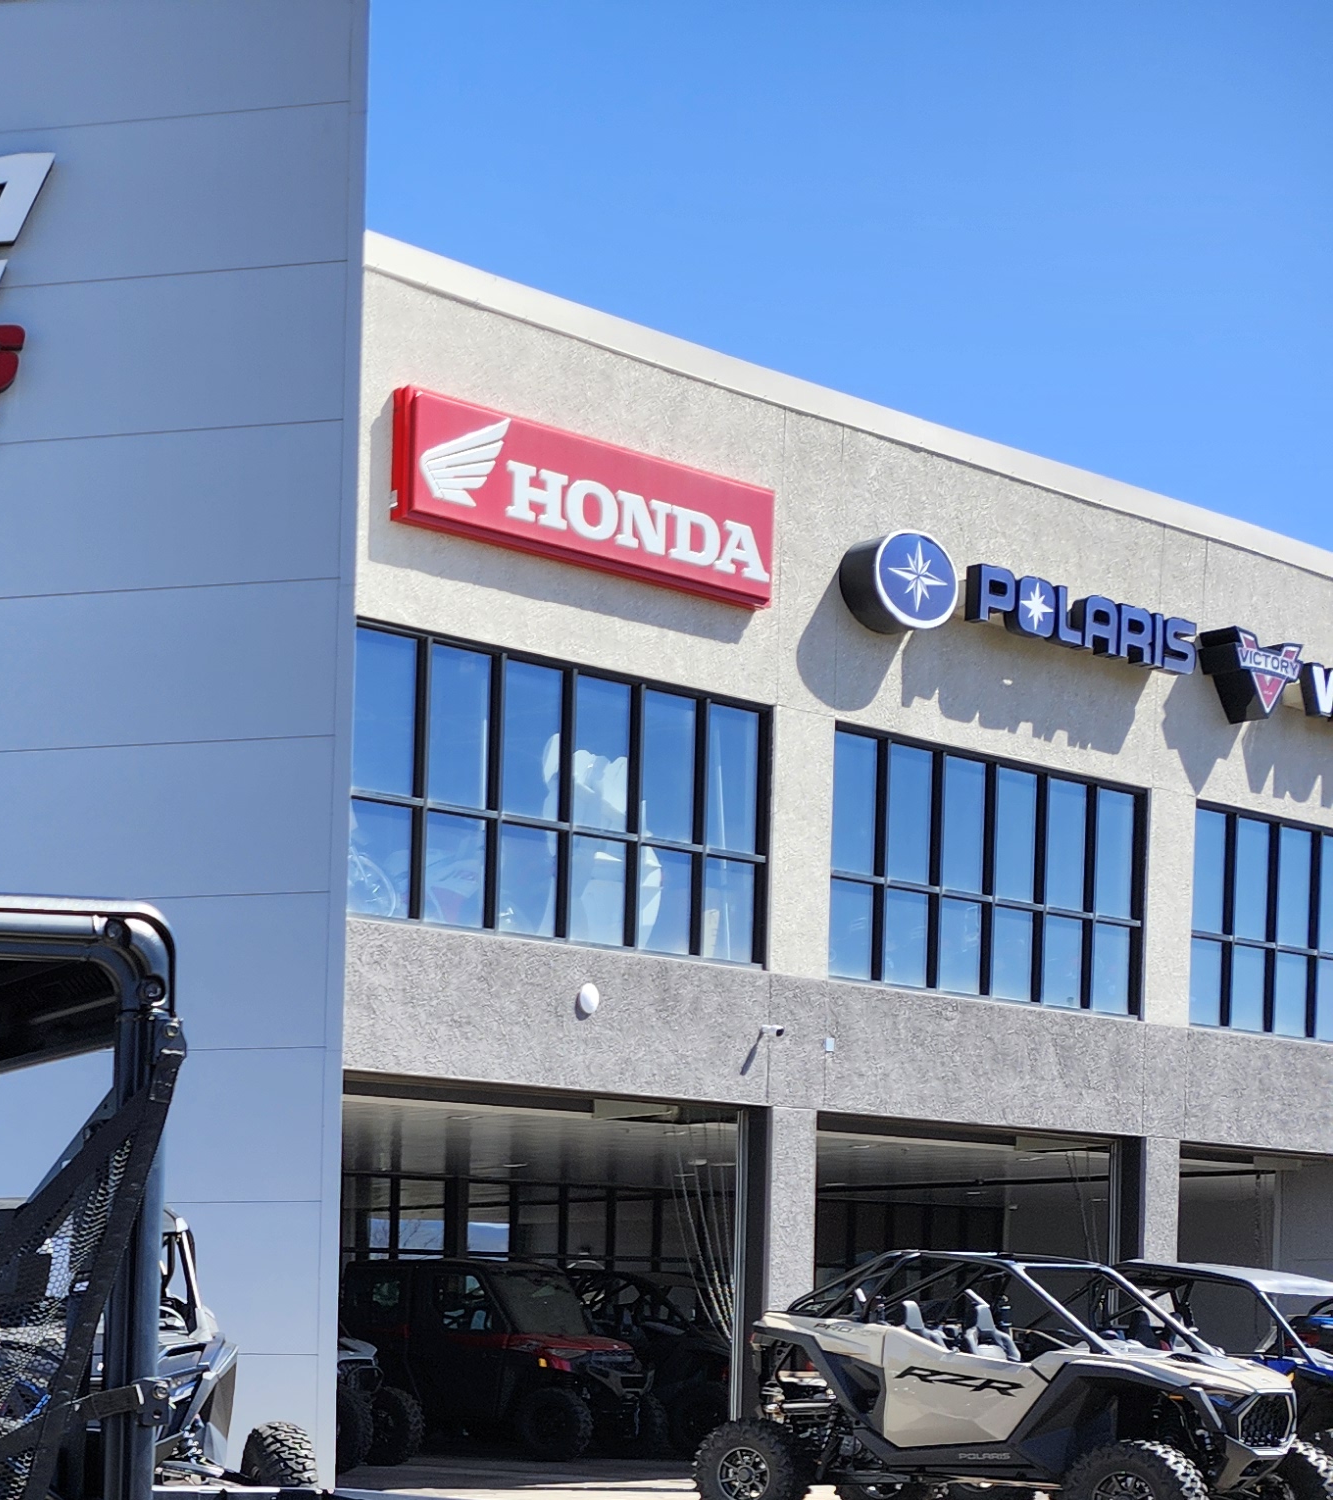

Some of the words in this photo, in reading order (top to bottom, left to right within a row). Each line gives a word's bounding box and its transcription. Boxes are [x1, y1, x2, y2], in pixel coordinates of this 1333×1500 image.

[505, 459, 770, 584] HONDA
[979, 563, 1196, 675] POLARIS
[1239, 650, 1299, 678] VICTORY
[894, 1366, 1025, 1397] RZR
[958, 1452, 1011, 1461] POLARIS
